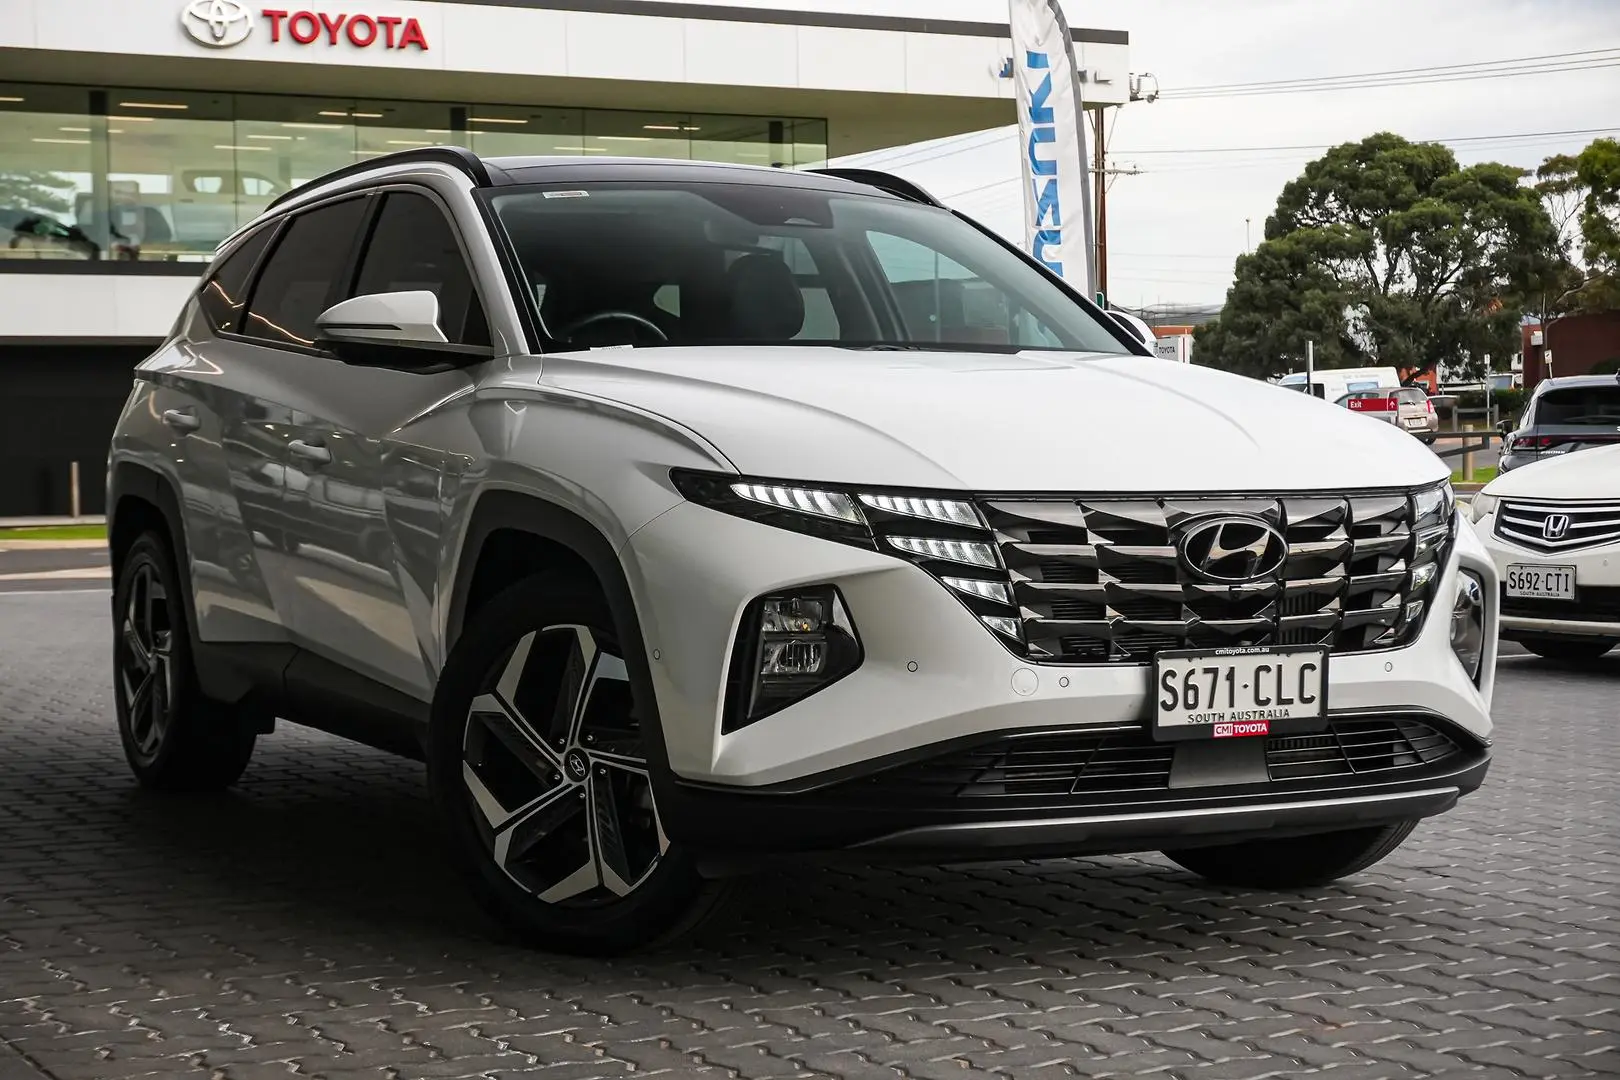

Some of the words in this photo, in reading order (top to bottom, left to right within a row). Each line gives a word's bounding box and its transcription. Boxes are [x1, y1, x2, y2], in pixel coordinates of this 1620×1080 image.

[262, 9, 428, 50] TOYOTA
[1159, 346, 1175, 354] TOYOTA
[1350, 400, 1362, 408] Exit
[1215, 647, 1270, 655] cmitoyota.com.au
[1187, 712, 1225, 723] SOUTH
[1230, 709, 1290, 721] AUSTRALIA
[1215, 726, 1232, 735] CMI
[1233, 723, 1267, 734] TOYOTA
